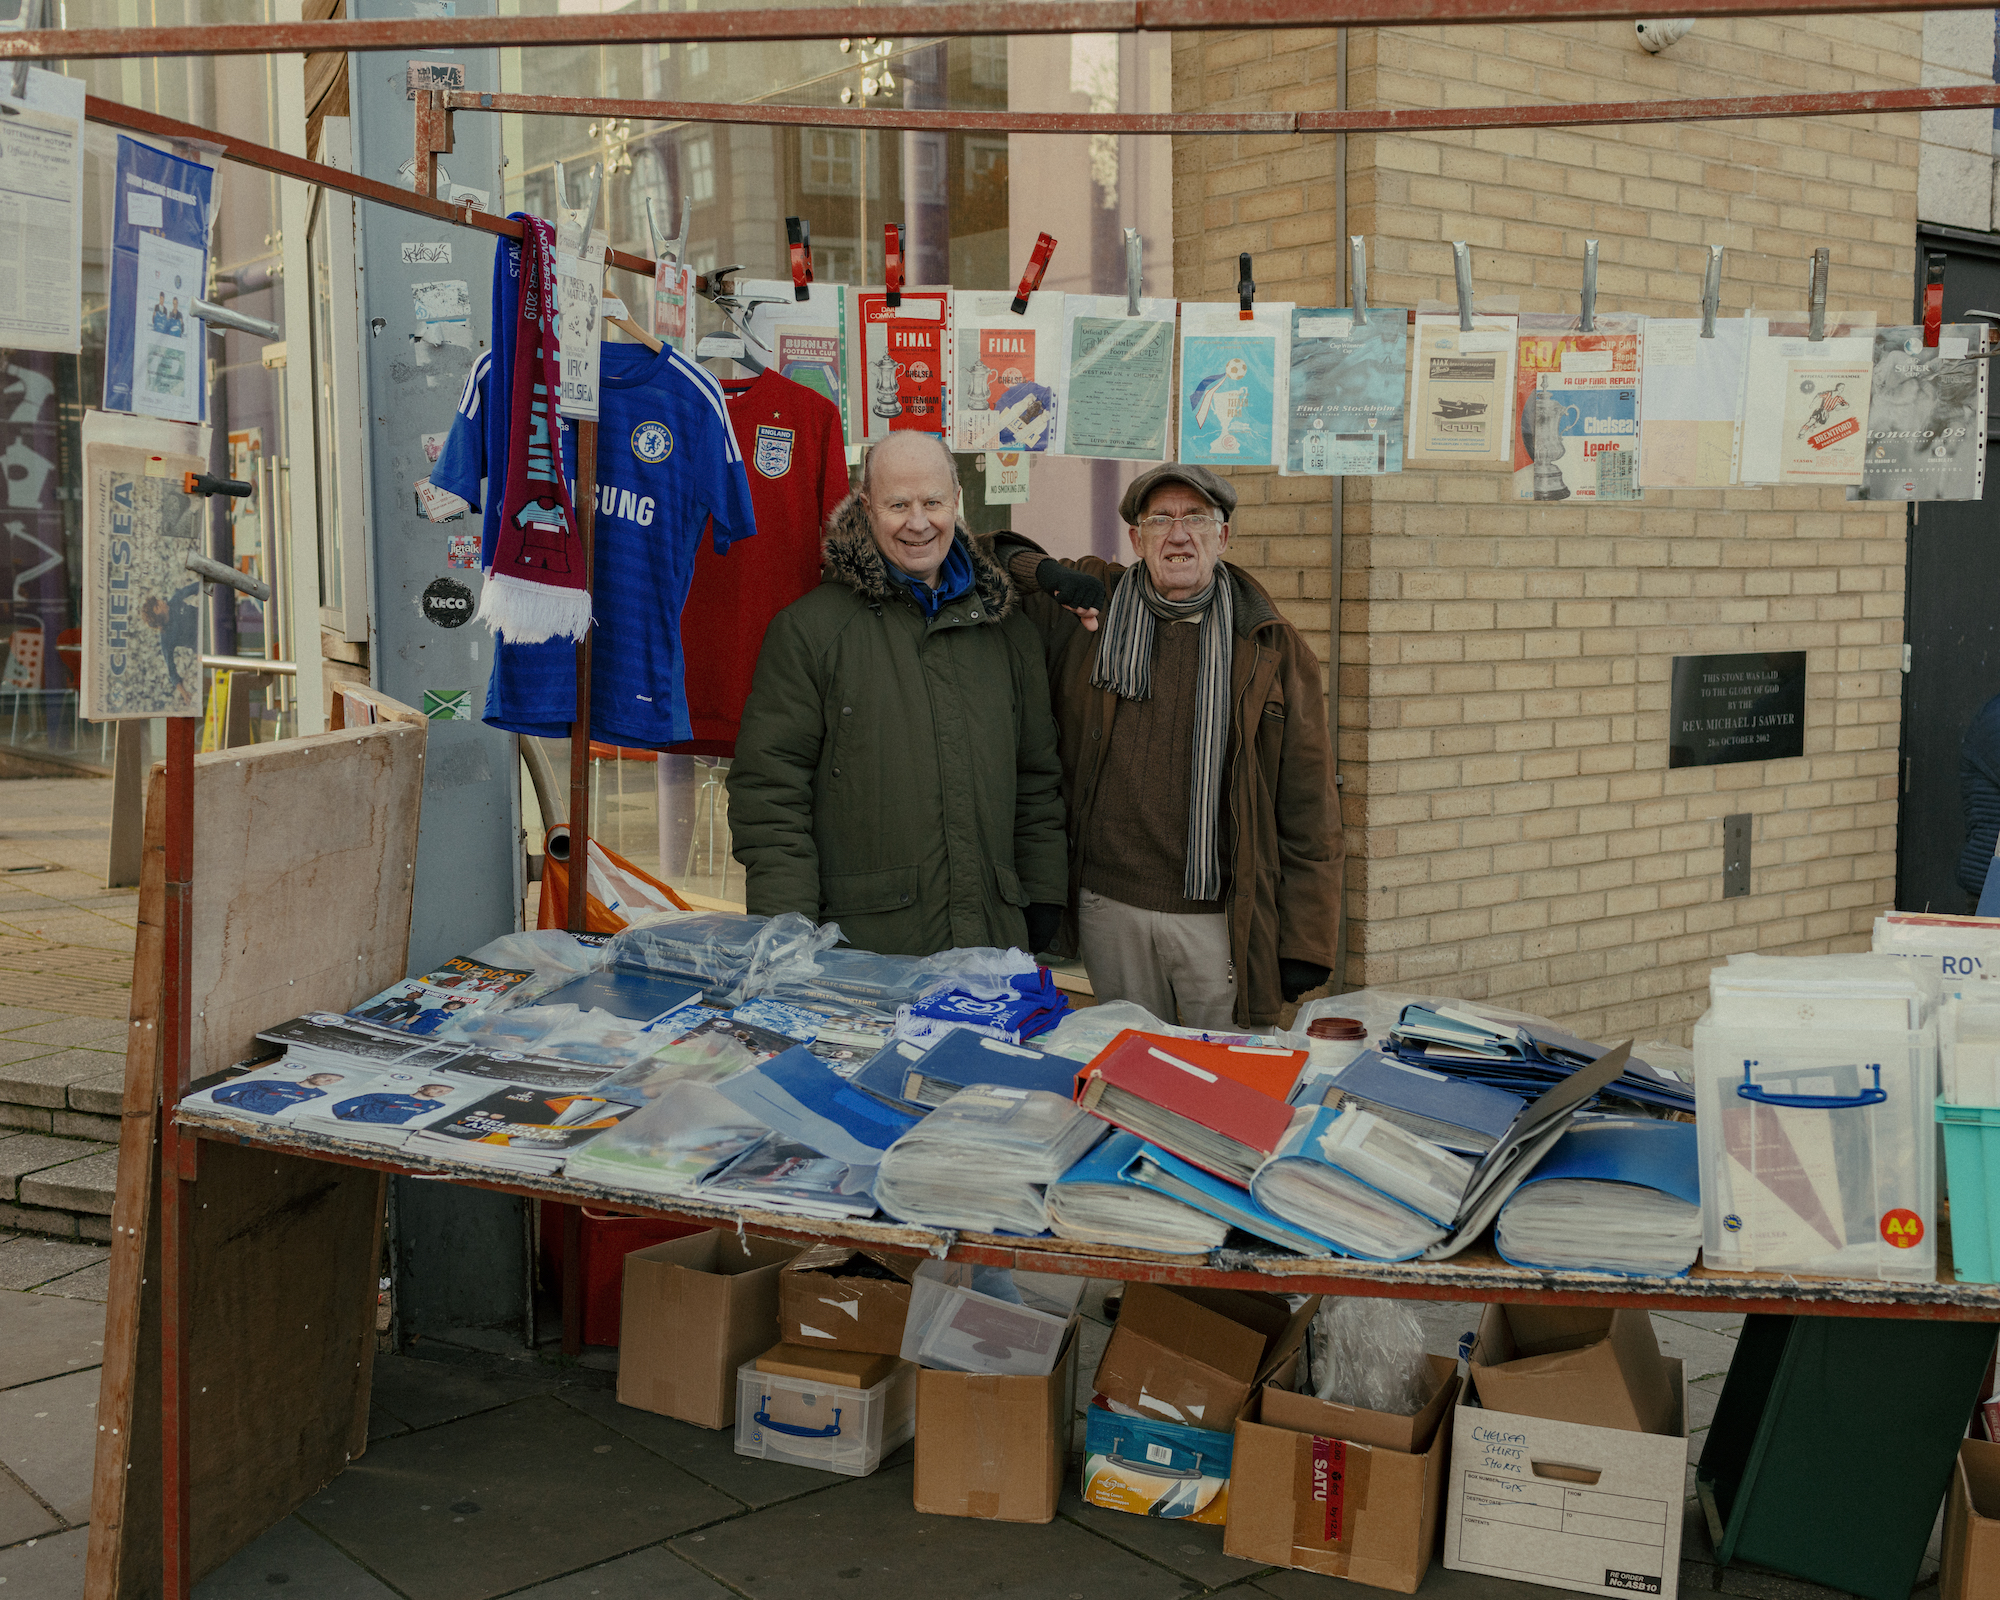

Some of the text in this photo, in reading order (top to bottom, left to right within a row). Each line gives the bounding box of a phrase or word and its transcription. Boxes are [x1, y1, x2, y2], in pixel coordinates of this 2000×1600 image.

[45, 137, 72, 149] HOTSPUR
[7, 144, 31, 157] Official
[33, 149, 71, 165] Programme
[538, 229, 552, 290] NOVEMBER
[523, 290, 537, 320] 2019
[785, 338, 836, 350] BURNLEY
[895, 332, 932, 347] FINAL
[988, 338, 1026, 353] FINAL
[1329, 342, 1342, 350] Cup
[1600, 341, 1616, 350] CUP
[1619, 341, 1636, 350] FINA
[819, 349, 836, 357] CLUB
[567, 358, 582, 378] IFK
[905, 370, 934, 378] CHELSEA
[1894, 364, 1930, 373] SUPER
[997, 376, 1027, 384] CHELSEA
[1564, 377, 1636, 385] FA CUP FINAL REPLAY
[560, 380, 594, 402] HELSEA
[901, 396, 939, 404] TOTTENHAM
[905, 405, 935, 414] HOTSPUR
[1296, 404, 1324, 412] Final
[1342, 404, 1396, 412] Stockholm
[642, 425, 667, 438] CHELSEA
[1583, 416, 1634, 434] Chelsea
[760, 428, 792, 438] ENGLAND
[1813, 421, 1853, 445] BRENTFORD
[1941, 428, 1966, 437] 98
[1821, 435, 1841, 447] FOOTBALL
[1583, 440, 1620, 457] Leeds
[1001, 470, 1019, 484] STOP
[990, 484, 1027, 494] NO SMOKING ZONE
[449, 543, 480, 555] jigtalk
[109, 480, 134, 678] CHELSEA
[96, 483, 106, 713] Evening Standard London Football
[429, 596, 468, 609] XECO
[1703, 670, 1779, 683] THIS STONE WAS LAID
[1701, 684, 1780, 698] TO THE GLORY OF GOD
[1727, 700, 1753, 710] BY THE
[1682, 713, 1795, 732] REV. MICHAEL J SAWYER
[1721, 735, 1755, 746] OCTOBER
[570, 933, 612, 944] CHELSE
[406, 984, 423, 993] FINAL
[424, 989, 450, 1000] WHISTLE
[839, 983, 866, 992] CHRONICLE
[464, 1115, 537, 1133] CHELSEA
[464, 1122, 541, 1139] ARSENAL
[1886, 1217, 1919, 1236] A4
[1471, 1426, 1527, 1445] CHELSEA
[1481, 1443, 1524, 1460] SHIRTS
[1480, 1457, 1522, 1473] SHORTS
[1313, 1458, 1328, 1502] SATU
[1330, 1482, 1339, 1496] dpd
[1466, 1495, 1488, 1504] DESTROY
[1329, 1506, 1338, 1519] by
[1464, 1518, 1490, 1526] CONTENTS
[1620, 1573, 1645, 1582] ORDER
[1609, 1578, 1658, 1592] No.ASB10
